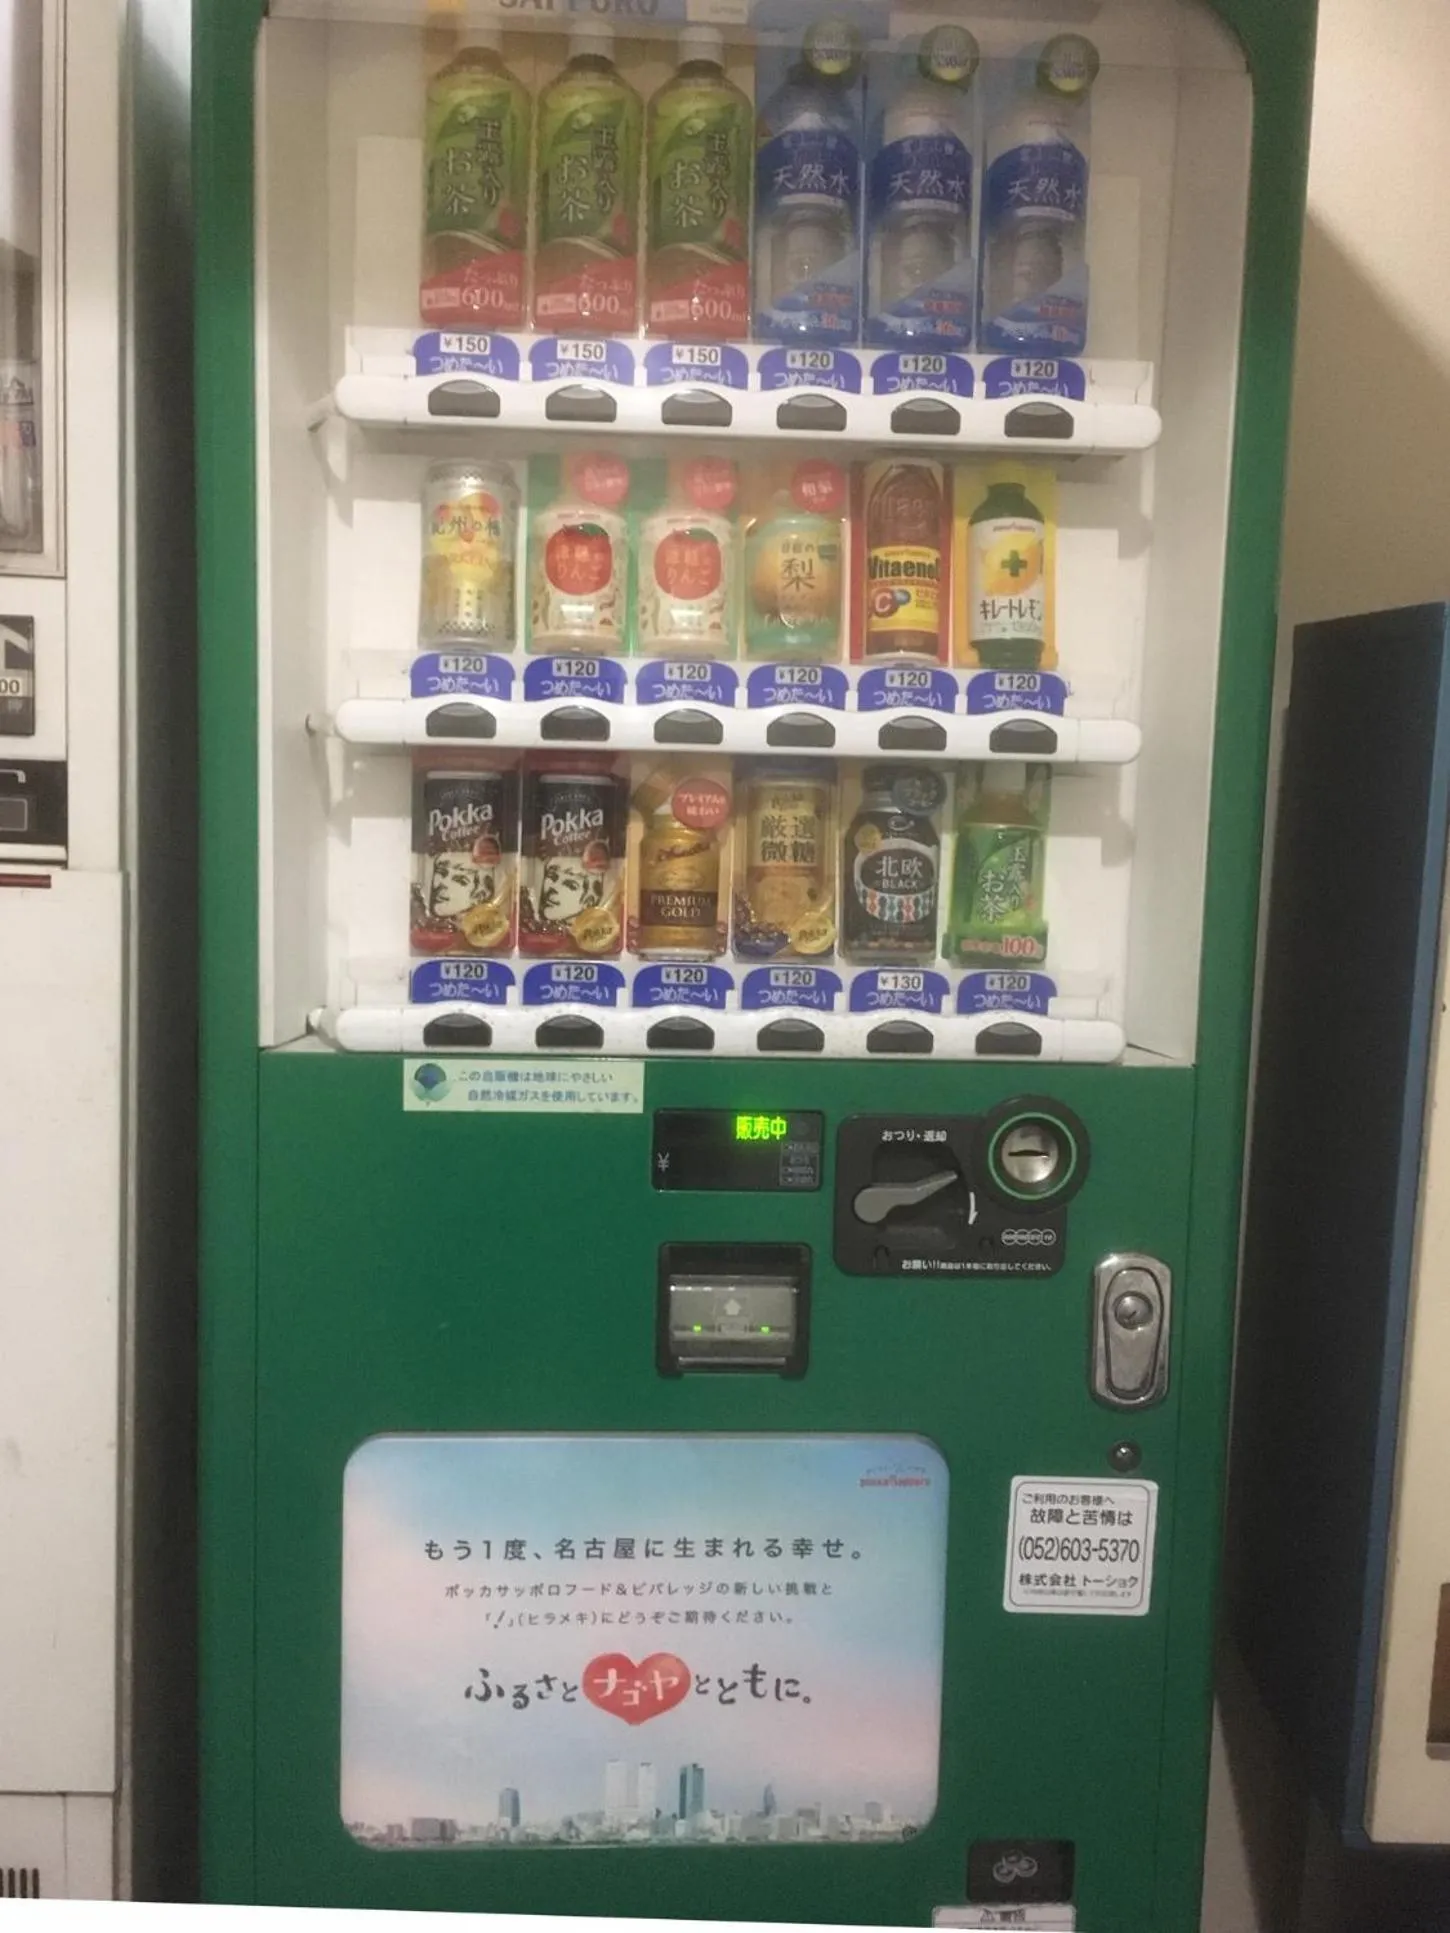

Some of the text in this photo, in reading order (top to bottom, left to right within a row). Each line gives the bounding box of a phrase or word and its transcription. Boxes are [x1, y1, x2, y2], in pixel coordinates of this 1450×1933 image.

[446, 147, 477, 216] お茶
[773, 164, 850, 194] 天然水
[890, 169, 966, 199] 天然水
[559, 155, 591, 223] お茶
[670, 161, 704, 229] お茶
[1008, 178, 1082, 208] 天然水
[444, 336, 488, 353] ¥150
[560, 342, 604, 358] ¥150
[675, 347, 719, 364] ¥150
[789, 352, 832, 368] ¥120
[903, 356, 943, 373] ¥120
[1015, 361, 1055, 377] ¥120
[781, 558, 816, 592] 梨
[875, 591, 892, 612] C
[443, 657, 483, 673] ¥120
[556, 661, 596, 677] ¥120
[667, 664, 707, 680] ¥120
[778, 667, 819, 683] ¥120
[888, 671, 928, 687] ¥120
[998, 674, 1037, 690] ¥120
[429, 803, 495, 837] Pokka
[541, 808, 604, 841] Pokka
[442, 825, 481, 842] Coffee
[553, 830, 592, 846] Coffee
[876, 856, 923, 879] 北欧
[881, 879, 918, 889] BLACK
[650, 895, 712, 907] PREMIUM
[981, 869, 1005, 922] お茶
[660, 906, 701, 917] GOLD
[444, 962, 485, 978] ¥120
[556, 965, 595, 981] ¥120
[664, 968, 705, 984] ¥120
[773, 970, 812, 985] ¥120
[881, 974, 921, 990] ¥130
[989, 975, 1027, 990] ¥120
[458, 1070, 614, 1084] この自販機は地球にやさしい
[735, 1115, 788, 1141] 販売中
[881, 1129, 948, 1143] おつり・返却
[1021, 1492, 1116, 1506] ご利用のお客様へ
[1029, 1507, 1134, 1527] 故障と苦情は
[423, 1536, 862, 1561] もう1度、名古屋に生まれる幸せ。
[1018, 1535, 1140, 1563] (052)603-5370
[1018, 1573, 1139, 1589] 株式会社 トーショク
